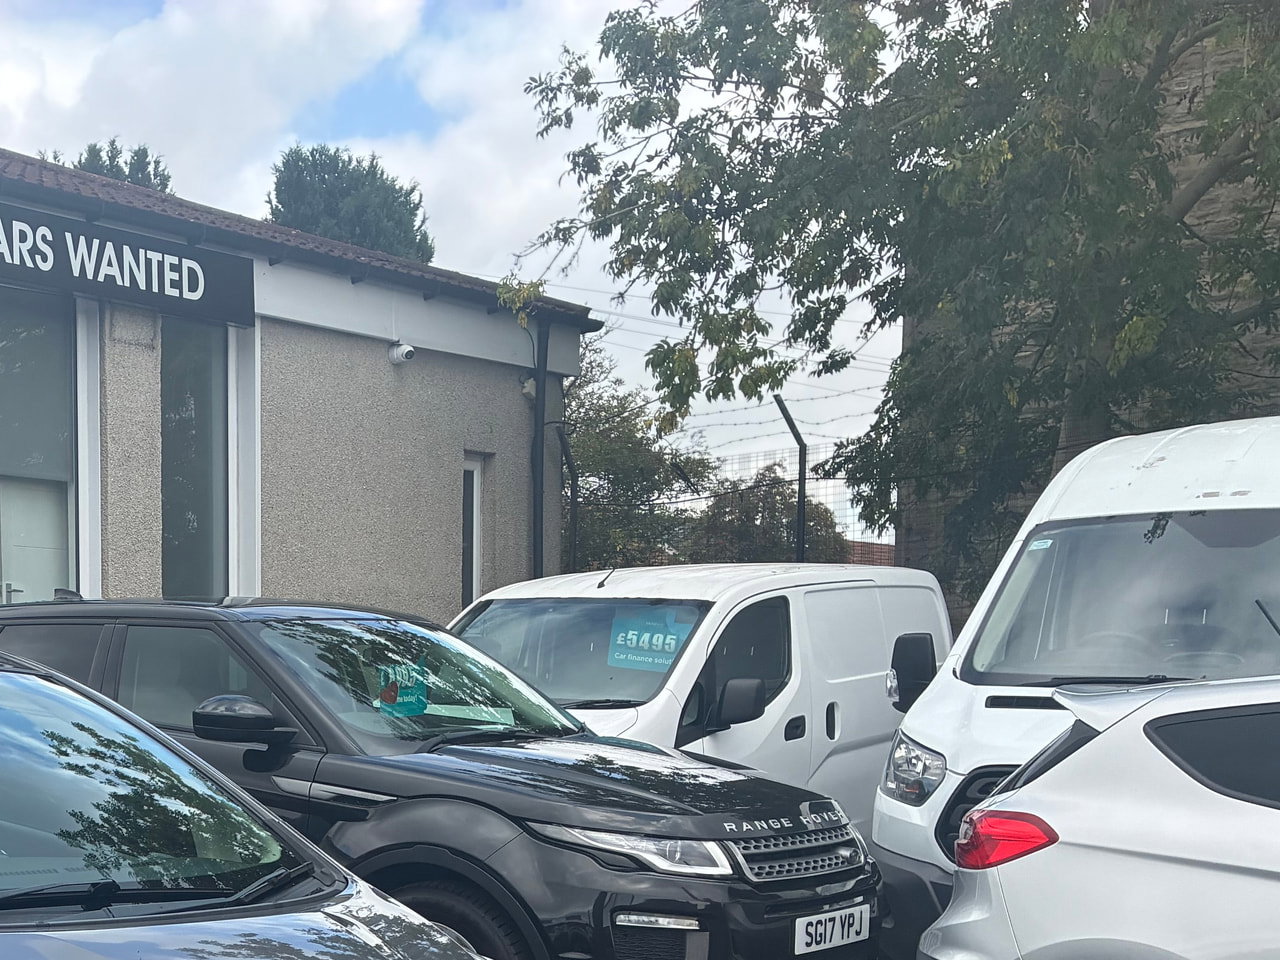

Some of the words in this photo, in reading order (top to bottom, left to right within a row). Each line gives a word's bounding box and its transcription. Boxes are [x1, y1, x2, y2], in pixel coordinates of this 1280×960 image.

[64, 231, 205, 301] WANTED
[616, 630, 677, 653] £5495
[627, 653, 653, 663] finance
[723, 817, 793, 833] RANGE
[805, 917, 836, 948] SG17
[840, 910, 863, 941] YPJ
